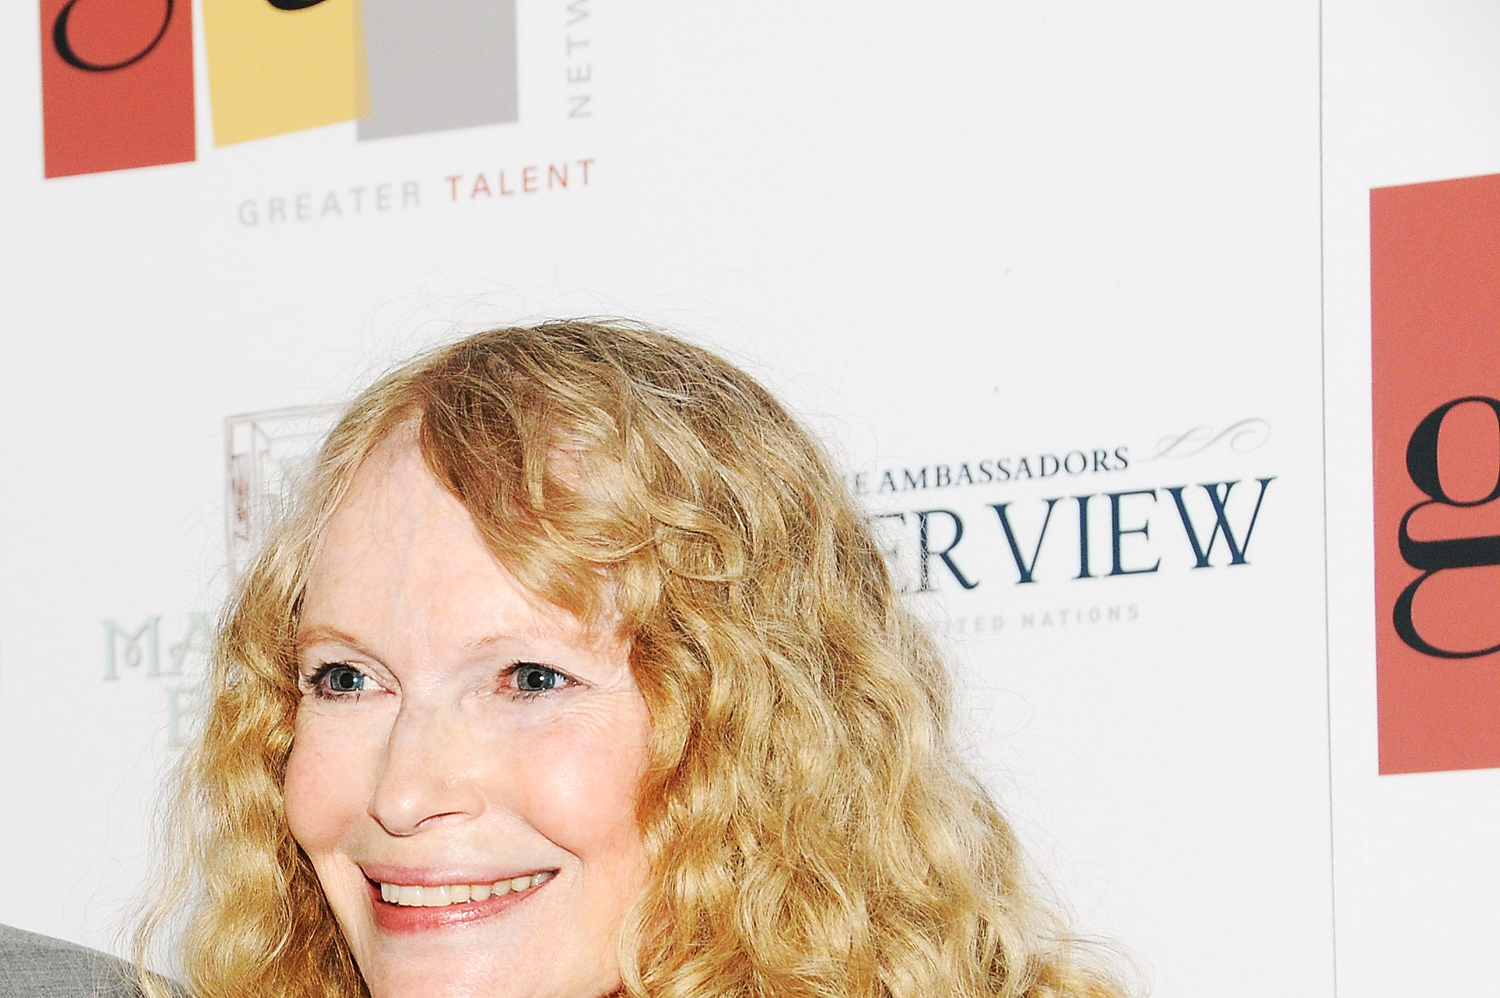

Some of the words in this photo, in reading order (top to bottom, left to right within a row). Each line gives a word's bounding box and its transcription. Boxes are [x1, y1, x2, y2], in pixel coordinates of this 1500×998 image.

[238, 180, 422, 227] GREATER
[445, 158, 596, 202] TALENT
[878, 446, 1130, 493] AMBASSADORS
[1021, 603, 1142, 630] NATIONS
